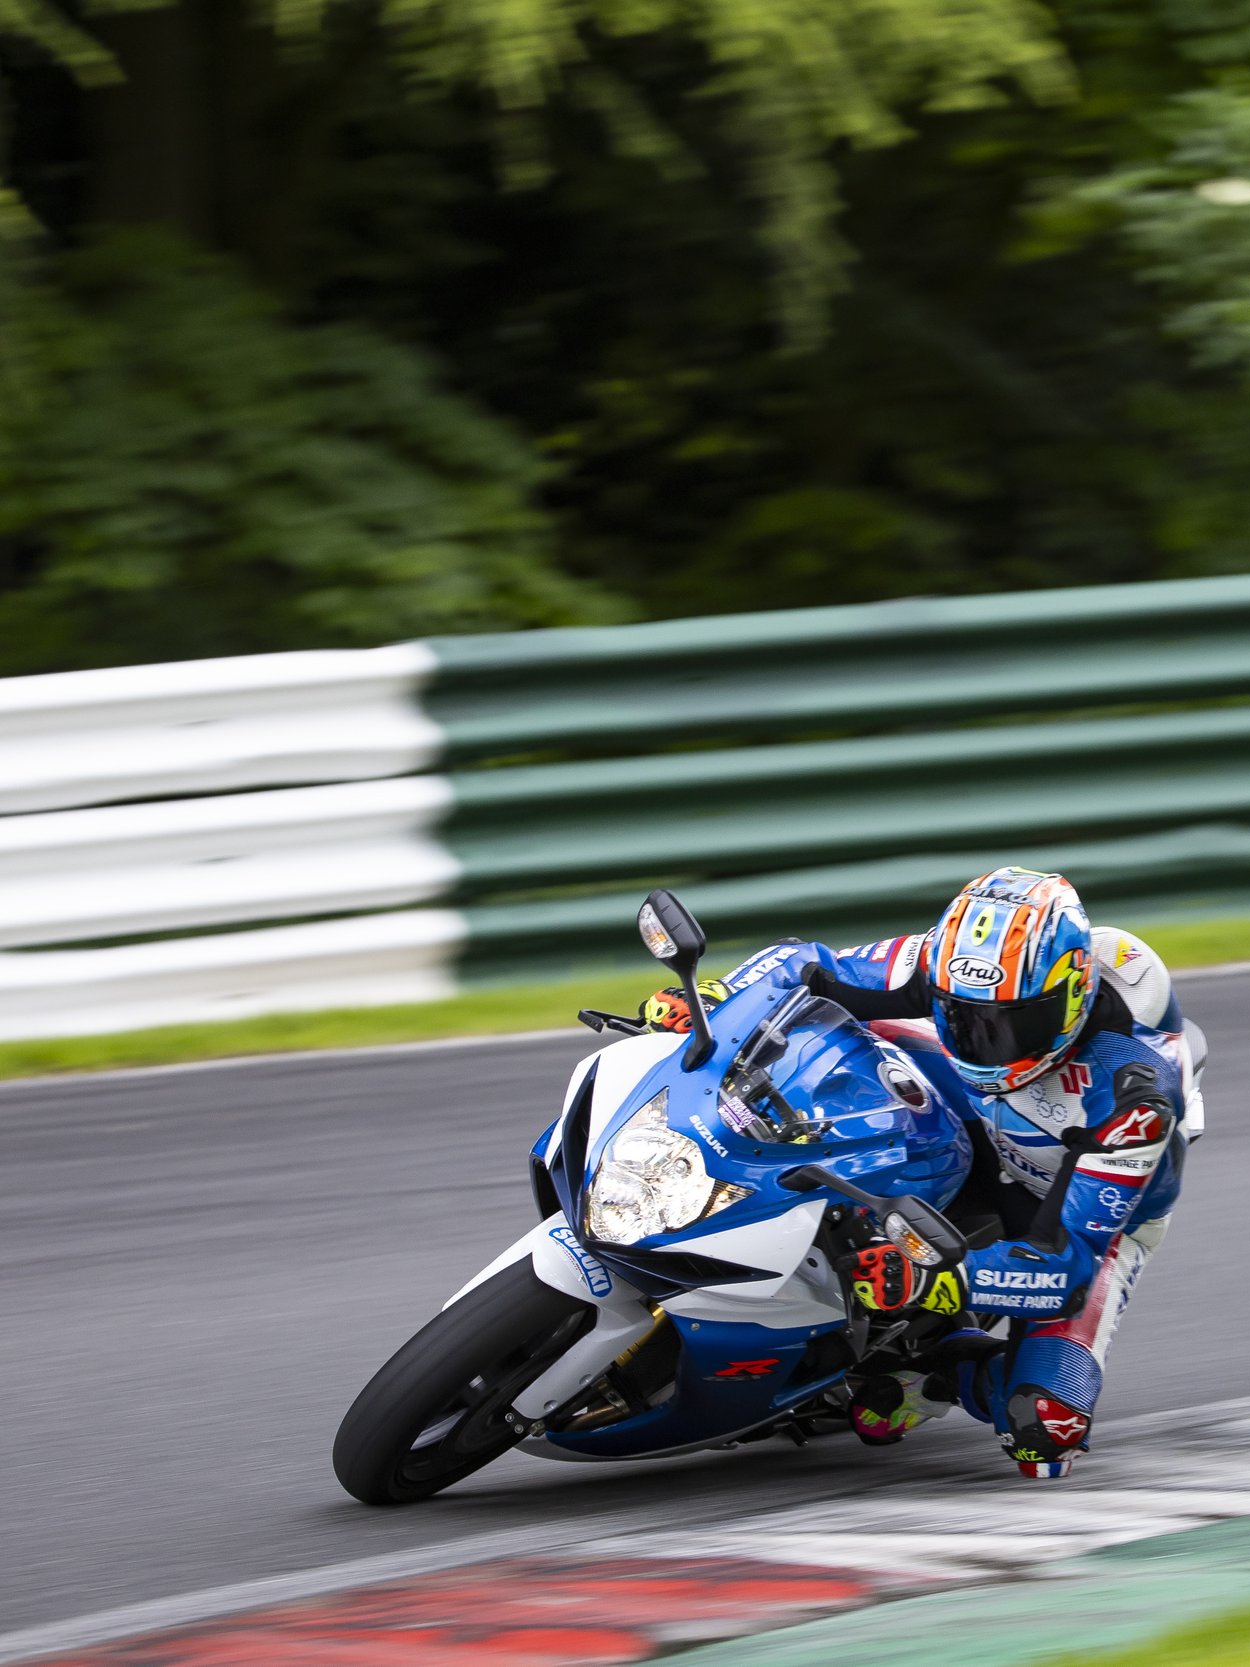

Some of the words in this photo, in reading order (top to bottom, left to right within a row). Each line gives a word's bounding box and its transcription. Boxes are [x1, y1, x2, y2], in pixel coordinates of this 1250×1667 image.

[951, 960, 996, 980] Arai
[689, 1115, 729, 1158] SUZUKI
[552, 1228, 610, 1293] SUZUKI
[975, 1269, 1068, 1289] SUZUKI
[971, 1292, 1024, 1308] VINTAGE
[1023, 1295, 1064, 1310] PARTS
